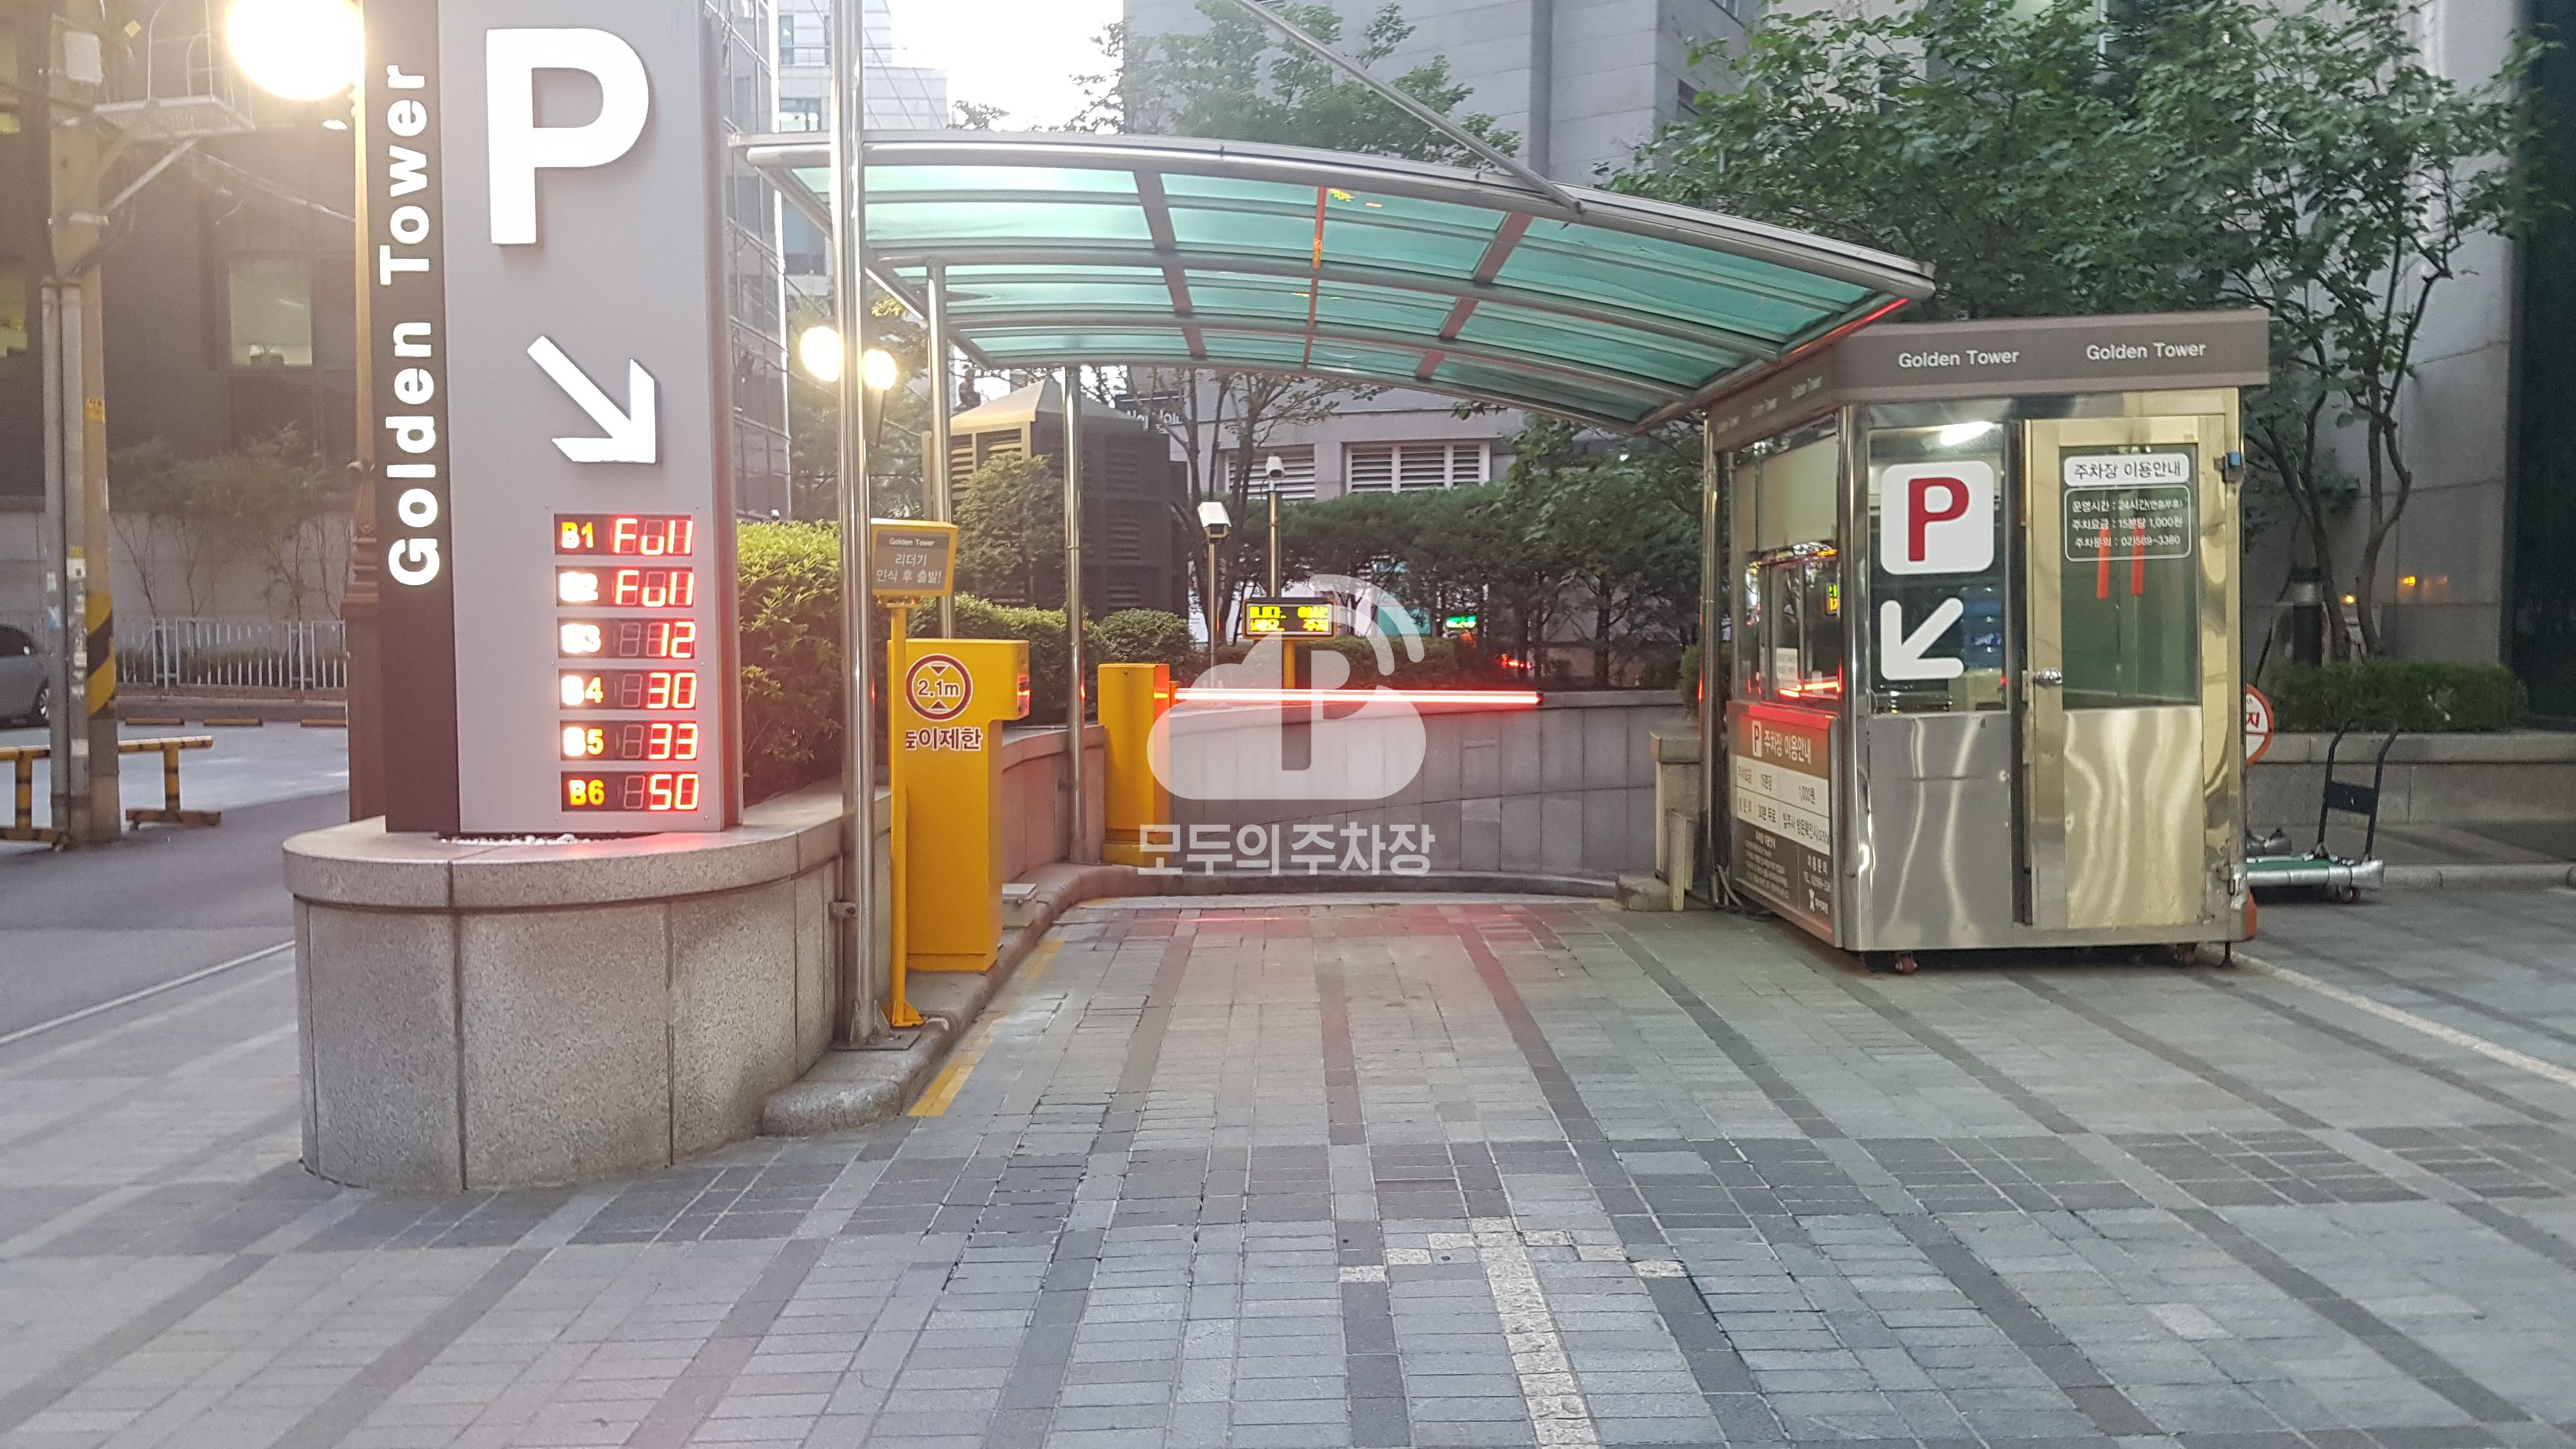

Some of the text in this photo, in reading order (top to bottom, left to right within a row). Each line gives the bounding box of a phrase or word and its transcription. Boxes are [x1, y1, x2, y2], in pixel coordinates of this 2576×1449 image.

[487, 28, 649, 244] P
[379, 64, 440, 586] Golden Tower
[1899, 349, 2020, 369] Golden Tower
[2086, 341, 2207, 361] Golden Tower
[2075, 460, 2181, 480] 주차장 이용안내
[1908, 477, 1969, 562] P
[2072, 500, 2110, 512] 운영시간
[2072, 518, 2109, 531] 주차요금
[2149, 516, 2183, 529] 1,000원
[561, 518, 693, 555] B1 Full
[889, 537, 935, 547] Golden Tower
[877, 569, 942, 583] 인식 후 출발!
[895, 553, 928, 567] 리더기
[615, 570, 694, 607] Full
[659, 621, 696, 658] 12
[560, 672, 697, 709] B4 30
[917, 679, 960, 696] 2.1m
[562, 723, 699, 760] B5 33
[1764, 729, 1812, 765] 주차장 이용안내
[569, 773, 700, 811] B6 50
